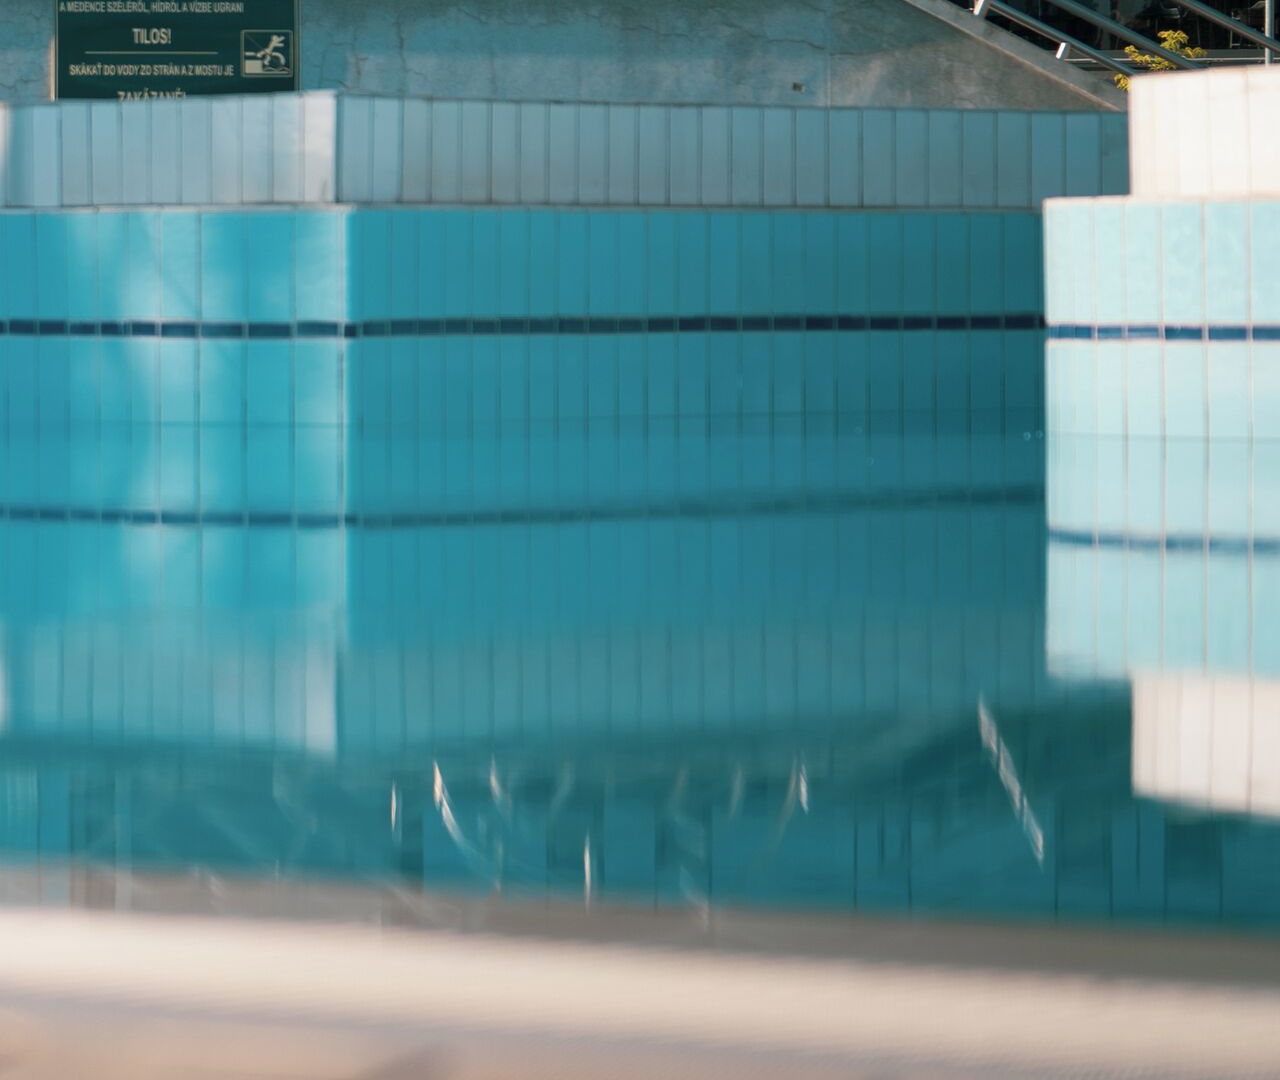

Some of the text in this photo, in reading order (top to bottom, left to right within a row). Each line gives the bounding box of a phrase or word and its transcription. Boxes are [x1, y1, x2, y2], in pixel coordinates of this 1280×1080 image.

[59, 1, 67, 13] A
[67, 1, 105, 13] MEDENCE
[214, 1, 244, 13] UGRANI
[131, 27, 172, 45] TILOS!
[104, 64, 116, 76] DO
[117, 64, 139, 76] VODY
[195, 64, 223, 76] MOSTU
[224, 64, 235, 76] JE
